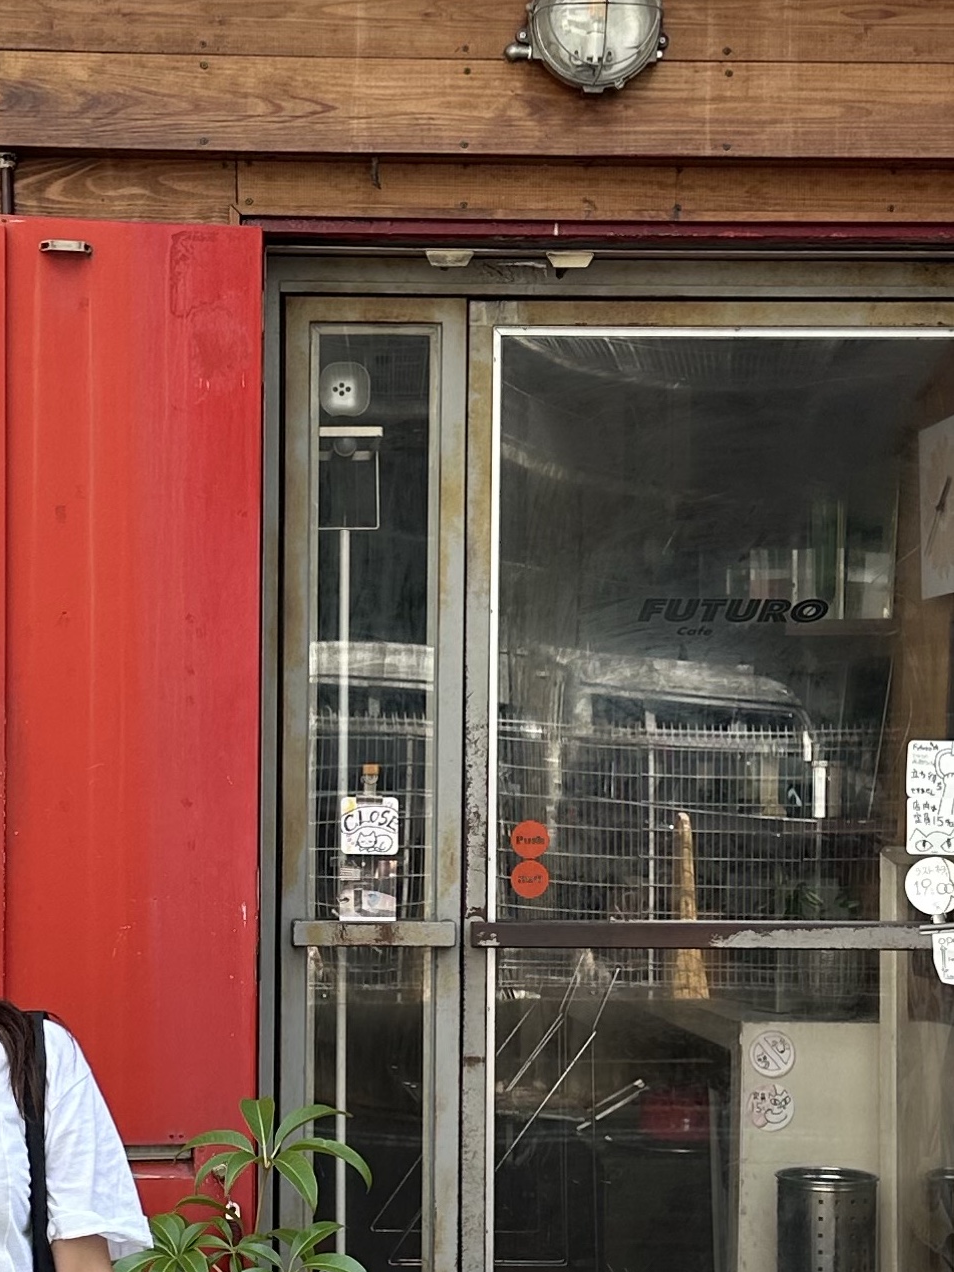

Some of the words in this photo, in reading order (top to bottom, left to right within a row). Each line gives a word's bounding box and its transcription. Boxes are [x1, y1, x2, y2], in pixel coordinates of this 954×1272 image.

[638, 598, 829, 623] FUTURO
[676, 626, 713, 637] Cafe
[343, 810, 399, 832] CLOSE
[515, 835, 545, 845] Push
